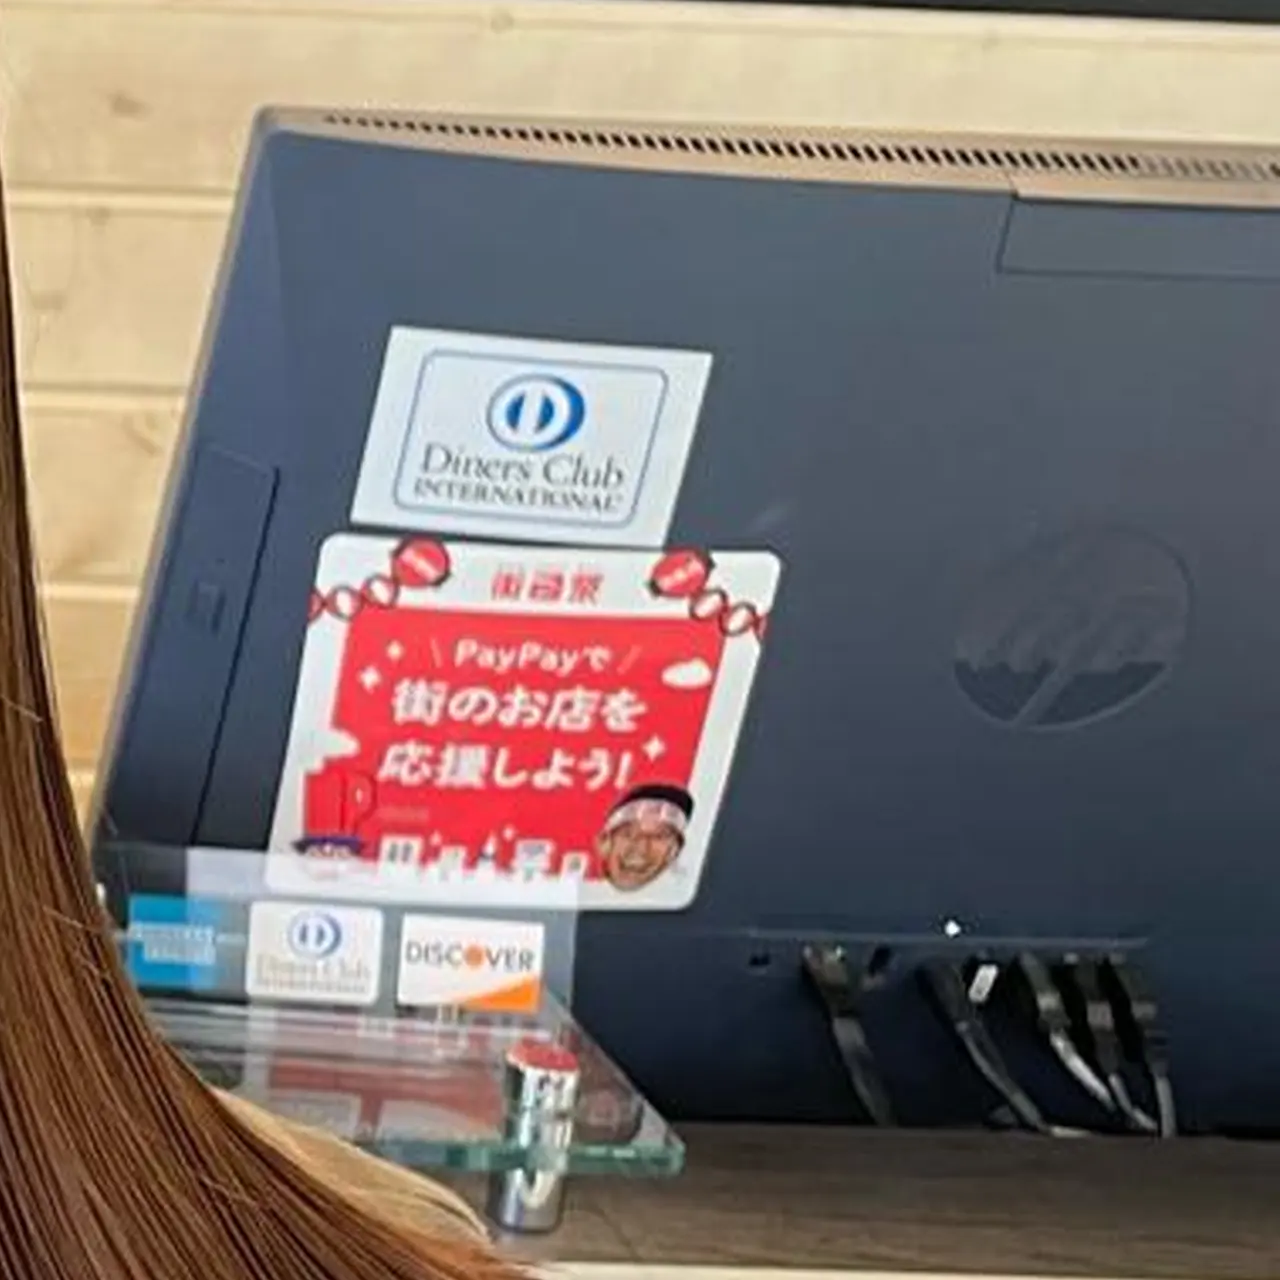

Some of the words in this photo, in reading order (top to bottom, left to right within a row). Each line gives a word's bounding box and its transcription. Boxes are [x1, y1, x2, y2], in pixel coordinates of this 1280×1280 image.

[422, 442, 530, 481] Diners
[542, 451, 624, 489] Club
[454, 638, 612, 677] PayPayで
[392, 678, 648, 732] 街のお店を
[379, 742, 632, 790] 応援しよう!
